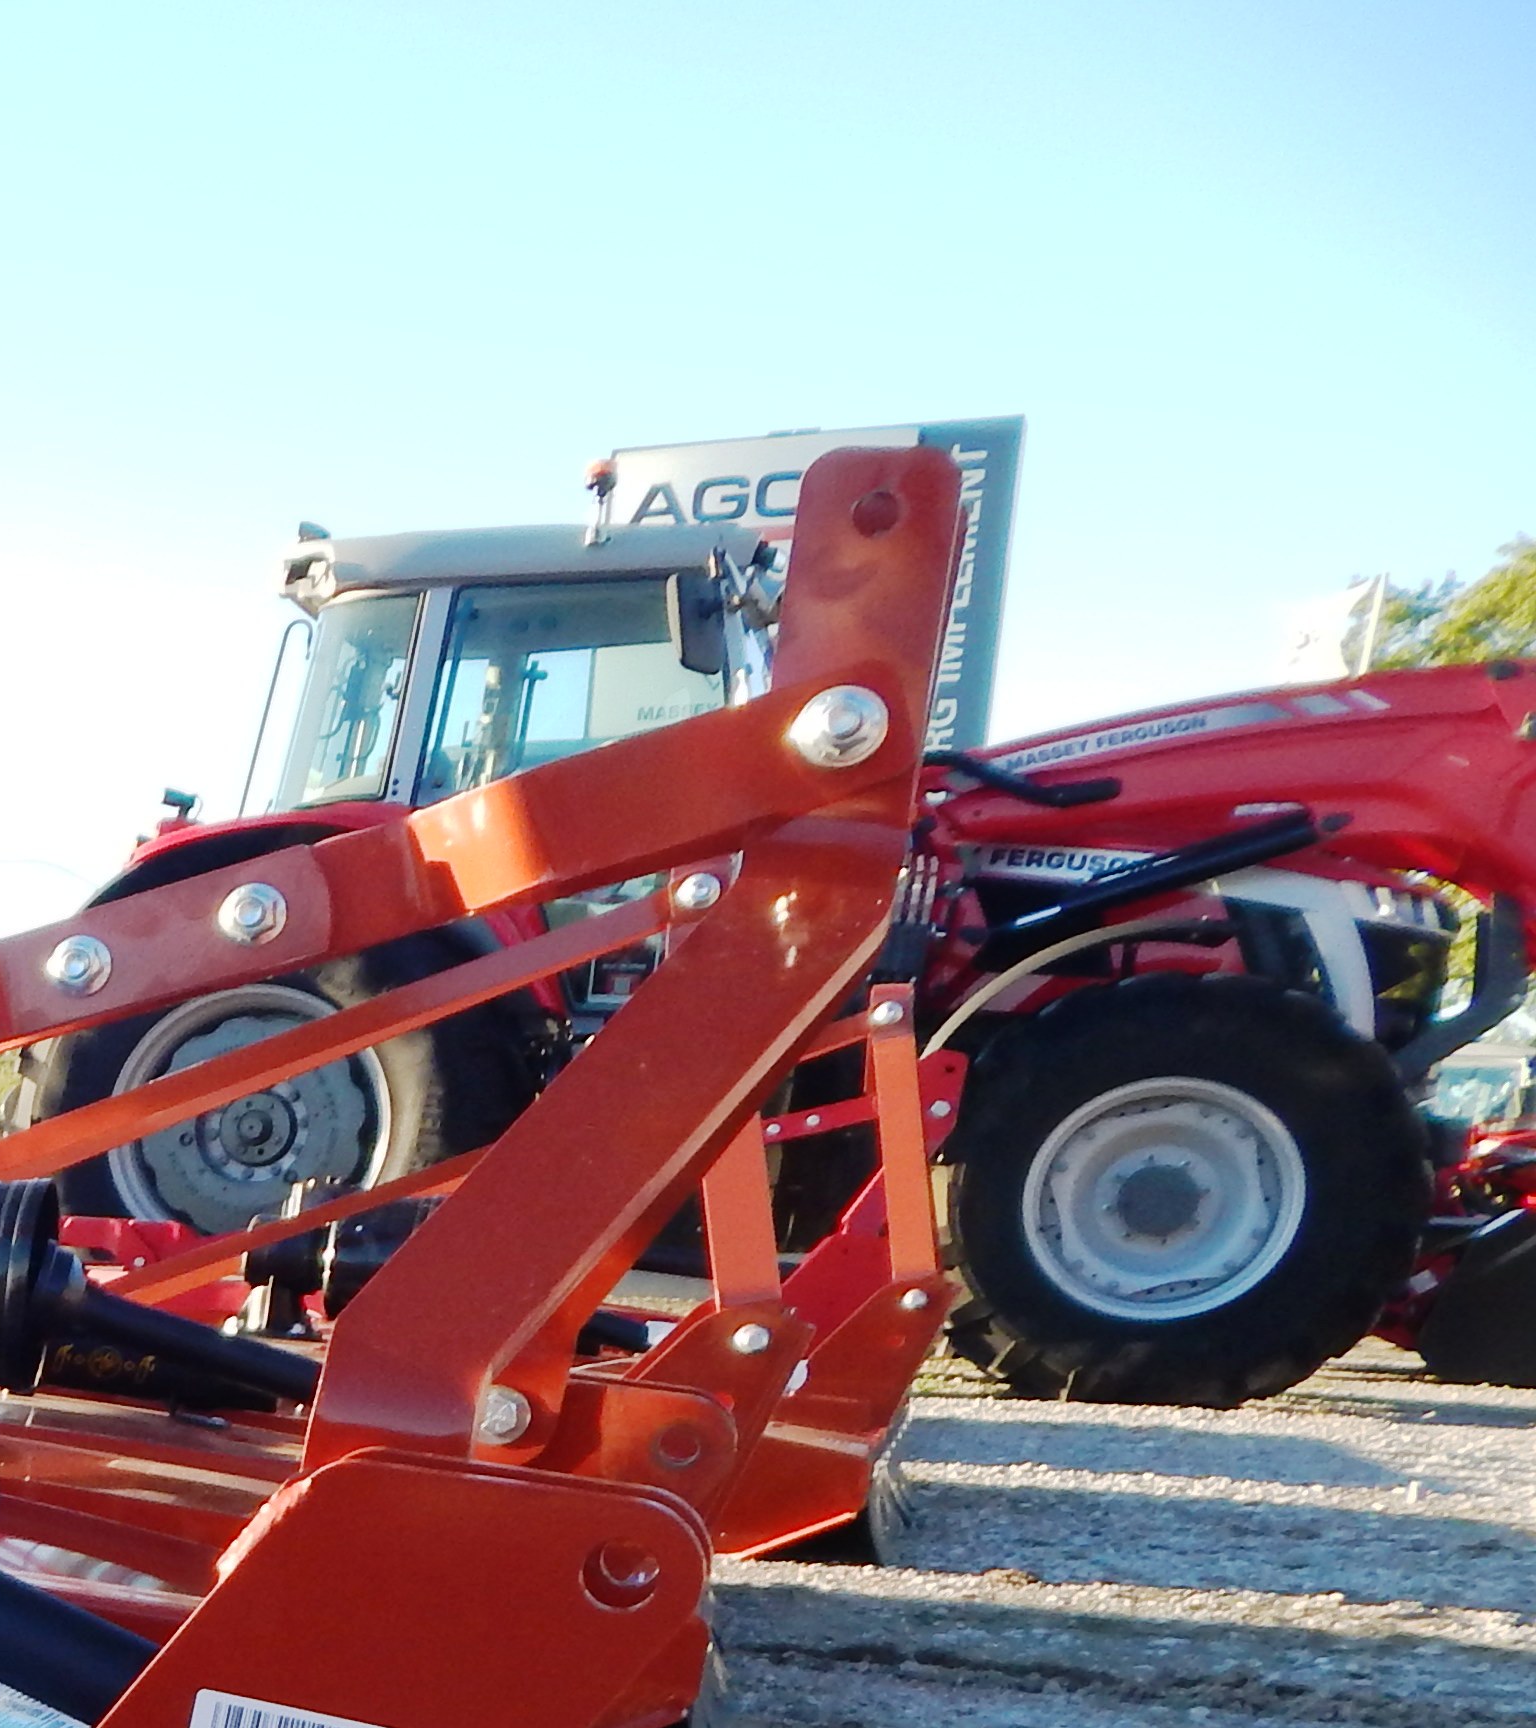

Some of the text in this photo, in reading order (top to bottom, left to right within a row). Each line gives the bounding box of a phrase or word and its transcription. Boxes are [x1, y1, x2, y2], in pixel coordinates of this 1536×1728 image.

[629, 471, 804, 525] AGC
[1004, 715, 1207, 771] MASSEY FERGUSON
[989, 849, 1133, 872] FERGUSO
